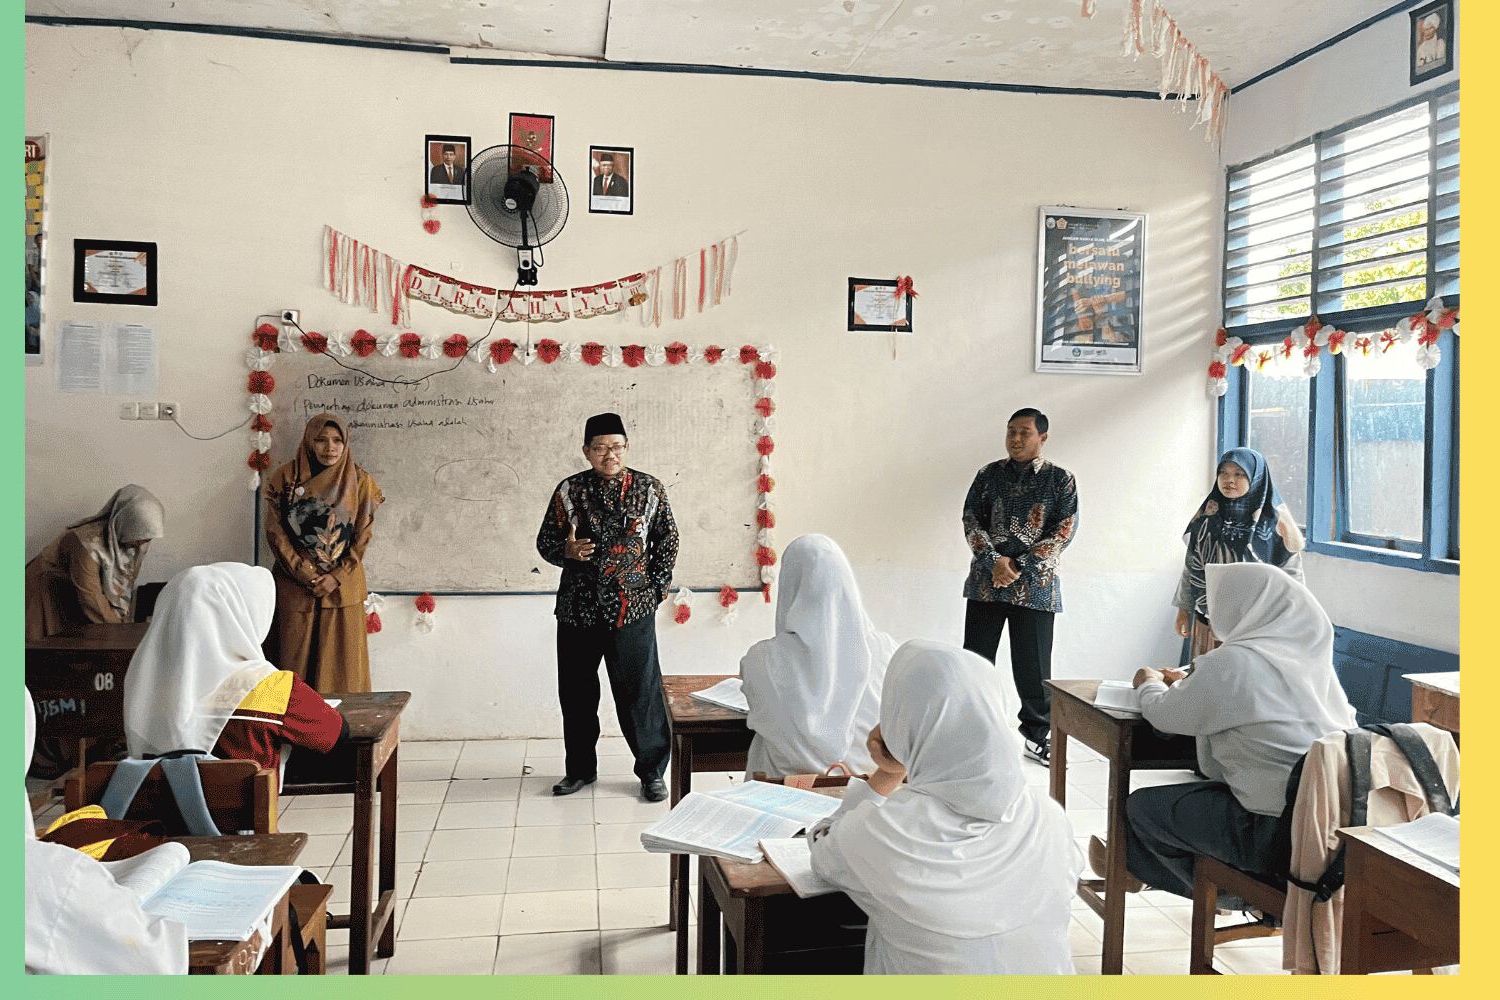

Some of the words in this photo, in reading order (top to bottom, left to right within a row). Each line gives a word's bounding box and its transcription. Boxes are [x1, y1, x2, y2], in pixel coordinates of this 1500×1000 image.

[1069, 243, 1120, 257] bersatu
[1064, 260, 1125, 272] melawan
[1067, 272, 1121, 288] bullying
[94, 672, 114, 691] 08
